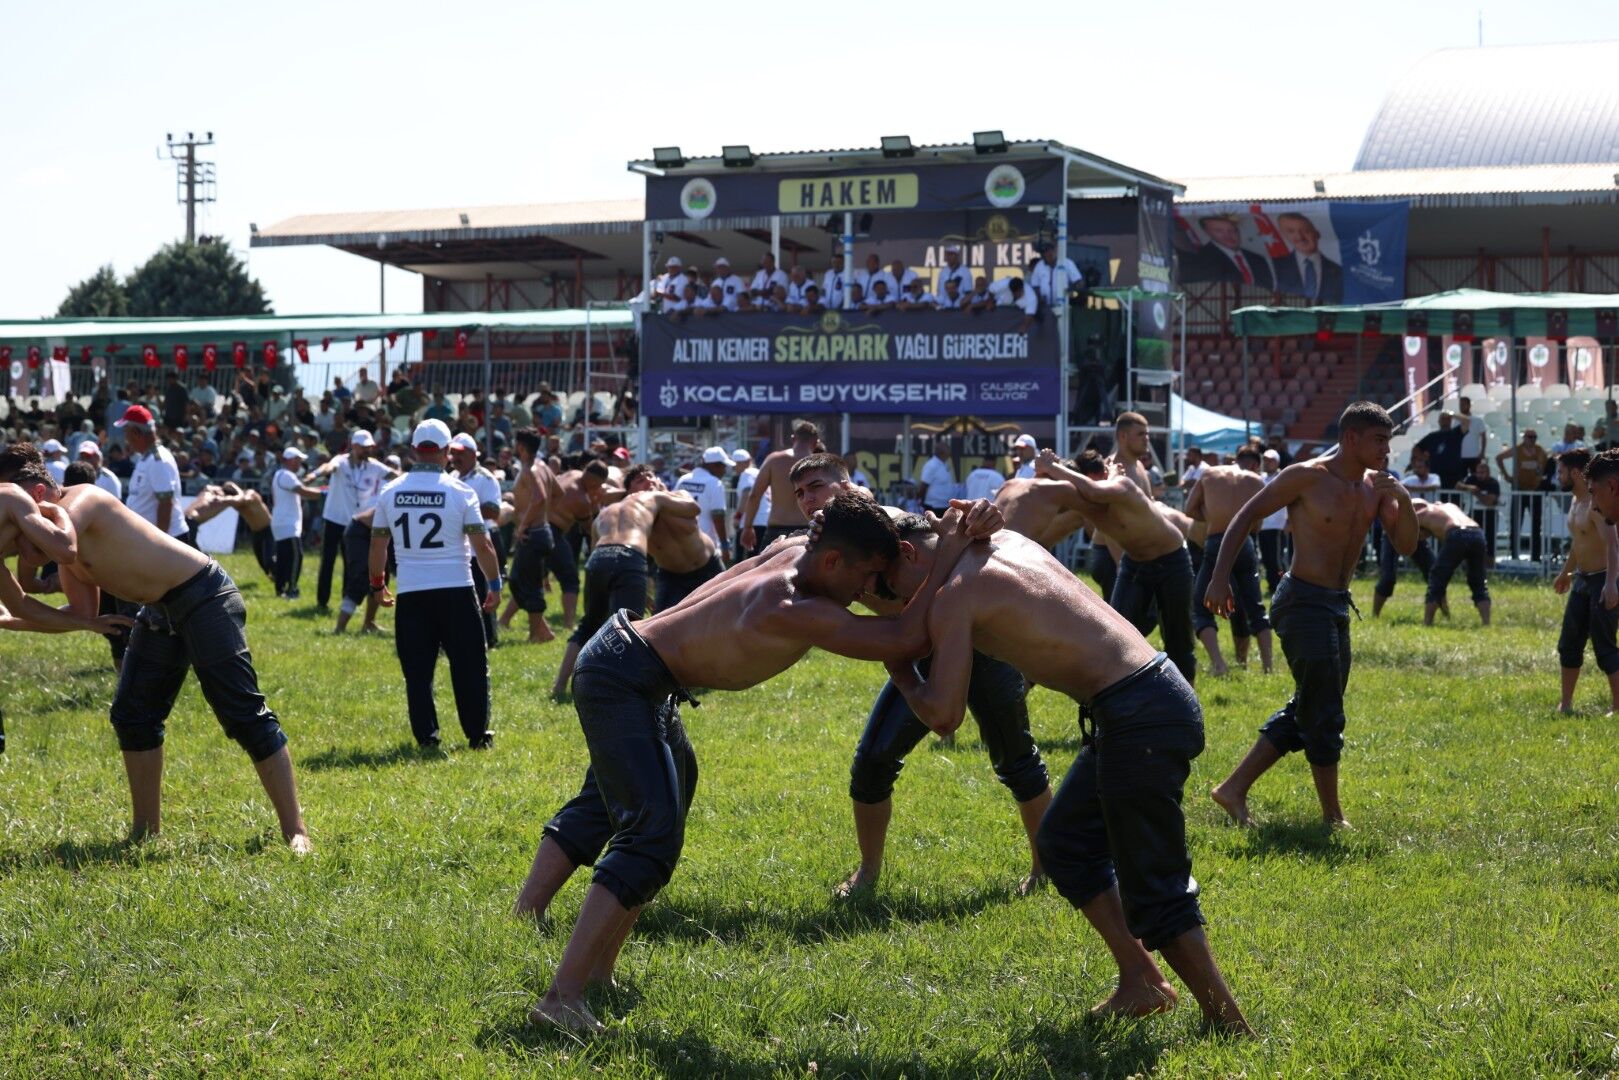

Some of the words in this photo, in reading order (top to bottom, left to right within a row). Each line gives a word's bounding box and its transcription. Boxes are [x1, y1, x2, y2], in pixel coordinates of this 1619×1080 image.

[801, 178, 896, 207] HAKEM
[924, 243, 985, 267] ALIN
[672, 338, 713, 363] ALTIN
[717, 337, 769, 362] KEMER
[774, 334, 889, 363] SEKAPARK
[894, 333, 938, 360] YAĞLI
[942, 333, 1028, 361] GÜREŞLERİ
[684, 385, 790, 402] KOCAELİ
[799, 383, 968, 404] BÜYÜKŞEHİR
[980, 391, 1028, 401] OLUYOR
[962, 433, 1018, 455] KEME
[396, 494, 443, 505] ÖZÜNLÜ
[394, 512, 445, 549] 12
